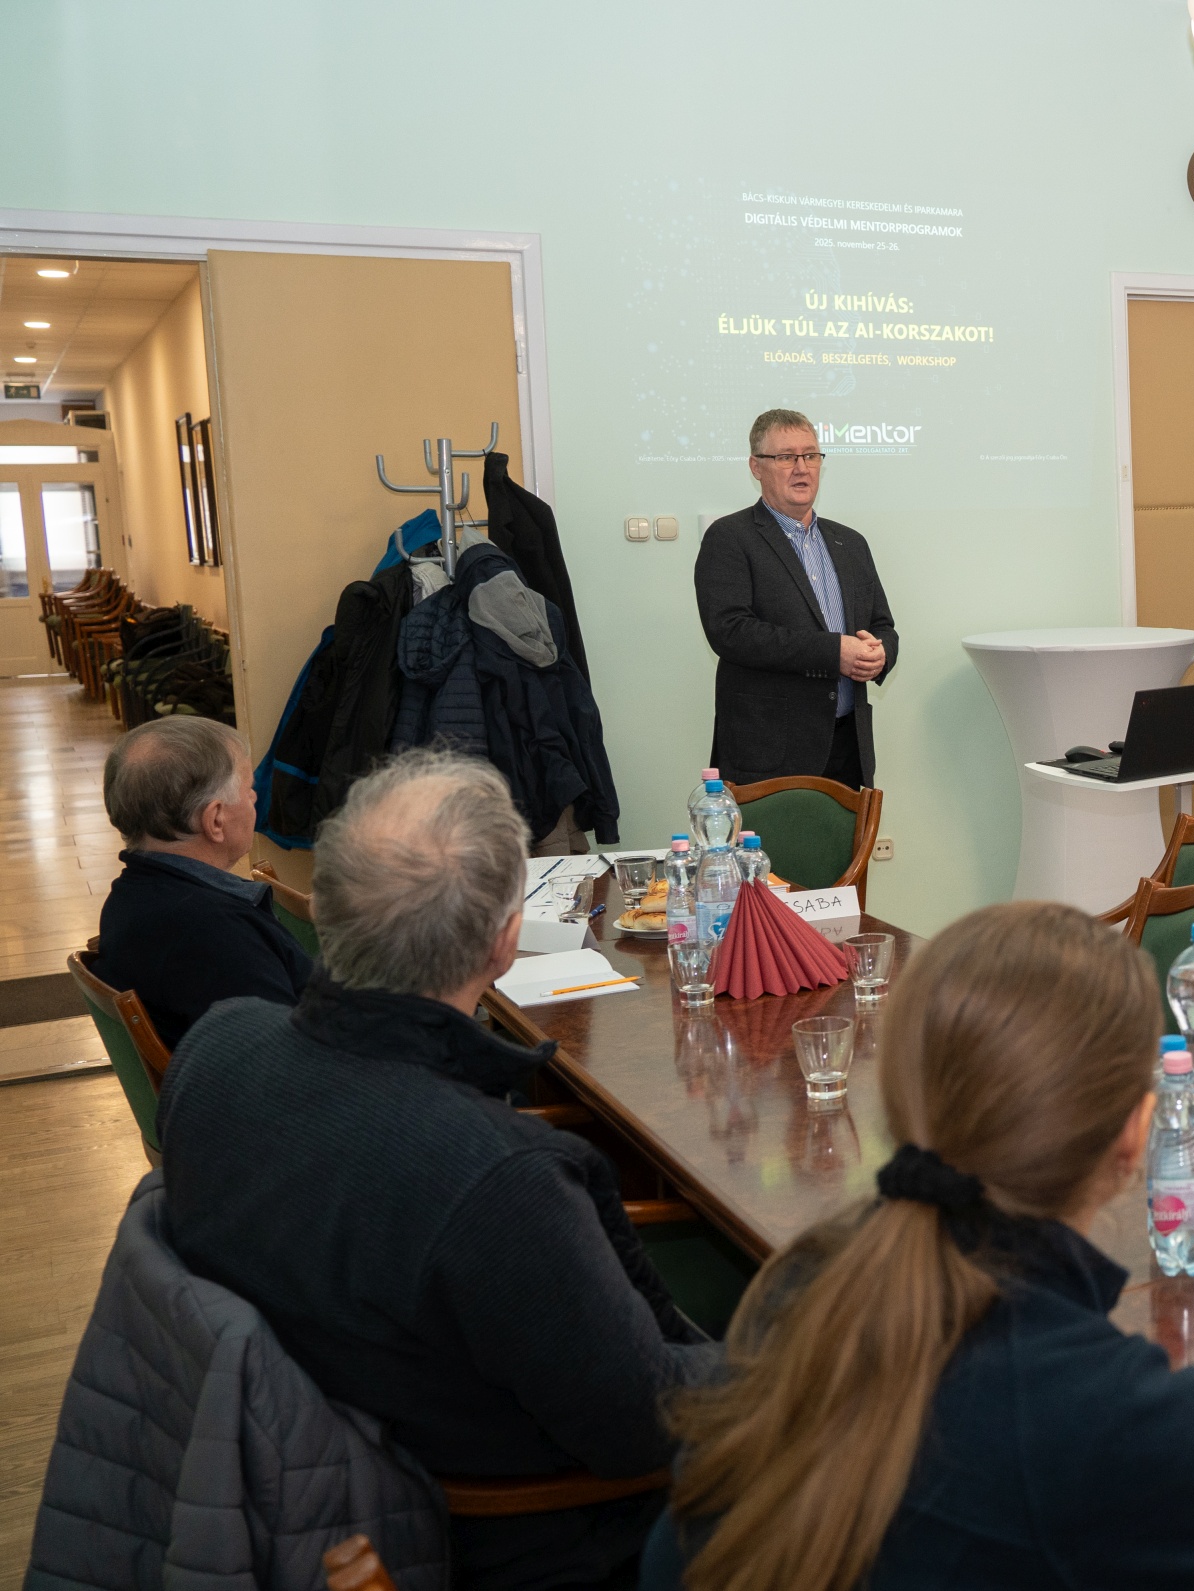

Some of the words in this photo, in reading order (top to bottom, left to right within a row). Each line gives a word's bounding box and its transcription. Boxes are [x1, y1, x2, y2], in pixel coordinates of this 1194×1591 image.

[742, 191, 798, 206] BÁCS-KISKUN
[799, 195, 845, 209] VÁRMEGYEI
[846, 200, 902, 213] KERESKEDELMI
[904, 203, 913, 213] ÉS
[914, 205, 963, 217] IPARKAMARA
[744, 211, 798, 227] DIGITÁLIS
[800, 214, 848, 230] VÉDELMI
[850, 219, 963, 237] MENTORPROGRAMOK
[814, 237, 836, 247] 2025.
[837, 240, 875, 250] november
[876, 241, 900, 251] 25-26.
[805, 288, 828, 310] ÚJ
[834, 291, 914, 314] KIHÍVÁS:
[717, 312, 777, 336] ÉLJÜK
[782, 315, 819, 337] TÚL
[823, 321, 850, 338] AZ
[854, 322, 994, 343] AI-KORSZAKOT!
[763, 349, 816, 365] ELŐADÁS,
[822, 351, 891, 366] BESZÉLGETÉS,
[896, 355, 957, 367] WORKSHOP
[784, 895, 842, 914] SABA
